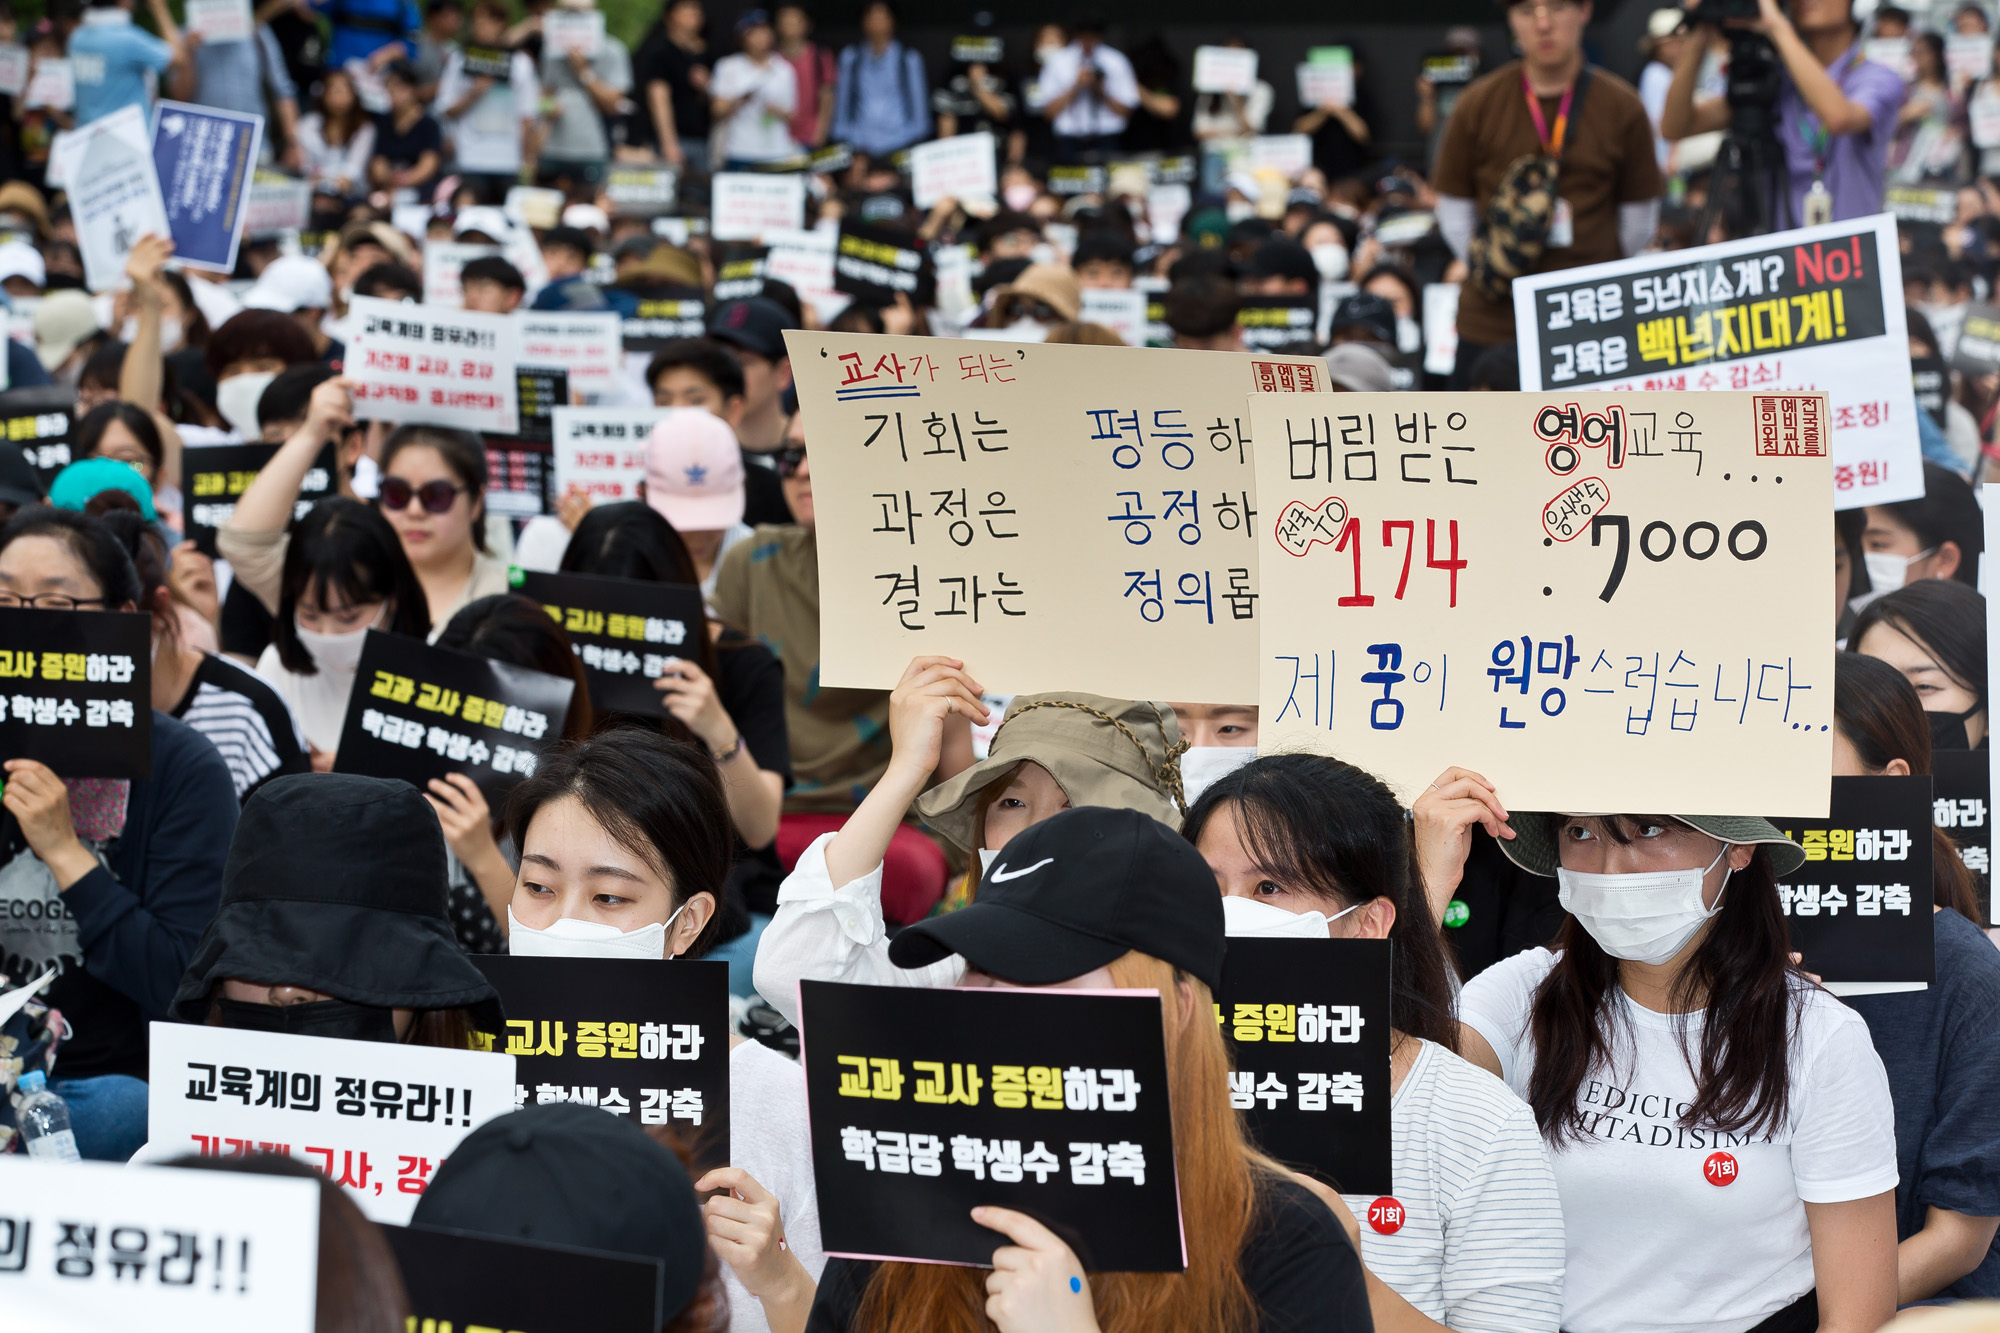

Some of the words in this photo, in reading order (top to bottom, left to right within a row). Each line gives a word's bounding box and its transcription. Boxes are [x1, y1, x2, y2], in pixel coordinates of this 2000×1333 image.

[1546, 283, 1623, 330] 교육은
[1632, 254, 1785, 315] 5년지소계?
[1794, 235, 1864, 288] No!
[1550, 336, 1629, 382] 교육은
[1636, 288, 1847, 367] 백년지대계!
[1729, 360, 1782, 389] 감소!
[863, 410, 1009, 463] 기회는
[1085, 408, 1253, 471] 평등하
[1780, 398, 1800, 455] 예비교사
[872, 488, 1019, 547] 과정은
[1107, 489, 1258, 546] 공정하
[1334, 517, 1468, 608] 174
[1592, 514, 1769, 605] 7000
[565, 607, 605, 636] 교사
[874, 564, 1027, 631] 결과는
[1122, 567, 1260, 625] 정의롭
[41, 652, 136, 683] 증원하라
[1274, 648, 1336, 731] 제
[1360, 642, 1448, 731] 꿈이
[11, 694, 81, 726] 학생수
[86, 699, 135, 728] 감축
[370, 670, 416, 704] 교과
[415, 682, 463, 717] 교사
[461, 693, 549, 740] 증원하라
[361, 707, 427, 750] 학급당
[426, 724, 491, 765] 학생수
[1802, 828, 1912, 861] 증원하라
[1956, 846, 1989, 874] 축
[1856, 883, 1911, 916] 감축
[504, 1019, 568, 1057] 교사
[575, 1021, 704, 1060] 증원하라
[1232, 1003, 1365, 1044] 증원하라
[185, 1061, 322, 1113] 교육계의
[334, 1075, 473, 1128] 정유라!!
[640, 1088, 704, 1126] 감축
[837, 1054, 905, 1101] 교과
[912, 1060, 983, 1107] 교사
[991, 1064, 1141, 1112] 증원하라
[1298, 1071, 1364, 1112] 감축
[397, 1154, 452, 1196] 강
[840, 1125, 944, 1177] 학급당
[950, 1134, 1060, 1184] 학생수
[1068, 1140, 1146, 1186] 감축
[1707, 1159, 1736, 1179] 기회
[1371, 1206, 1401, 1226] 기회
[55, 1218, 250, 1294] 정유라!!
